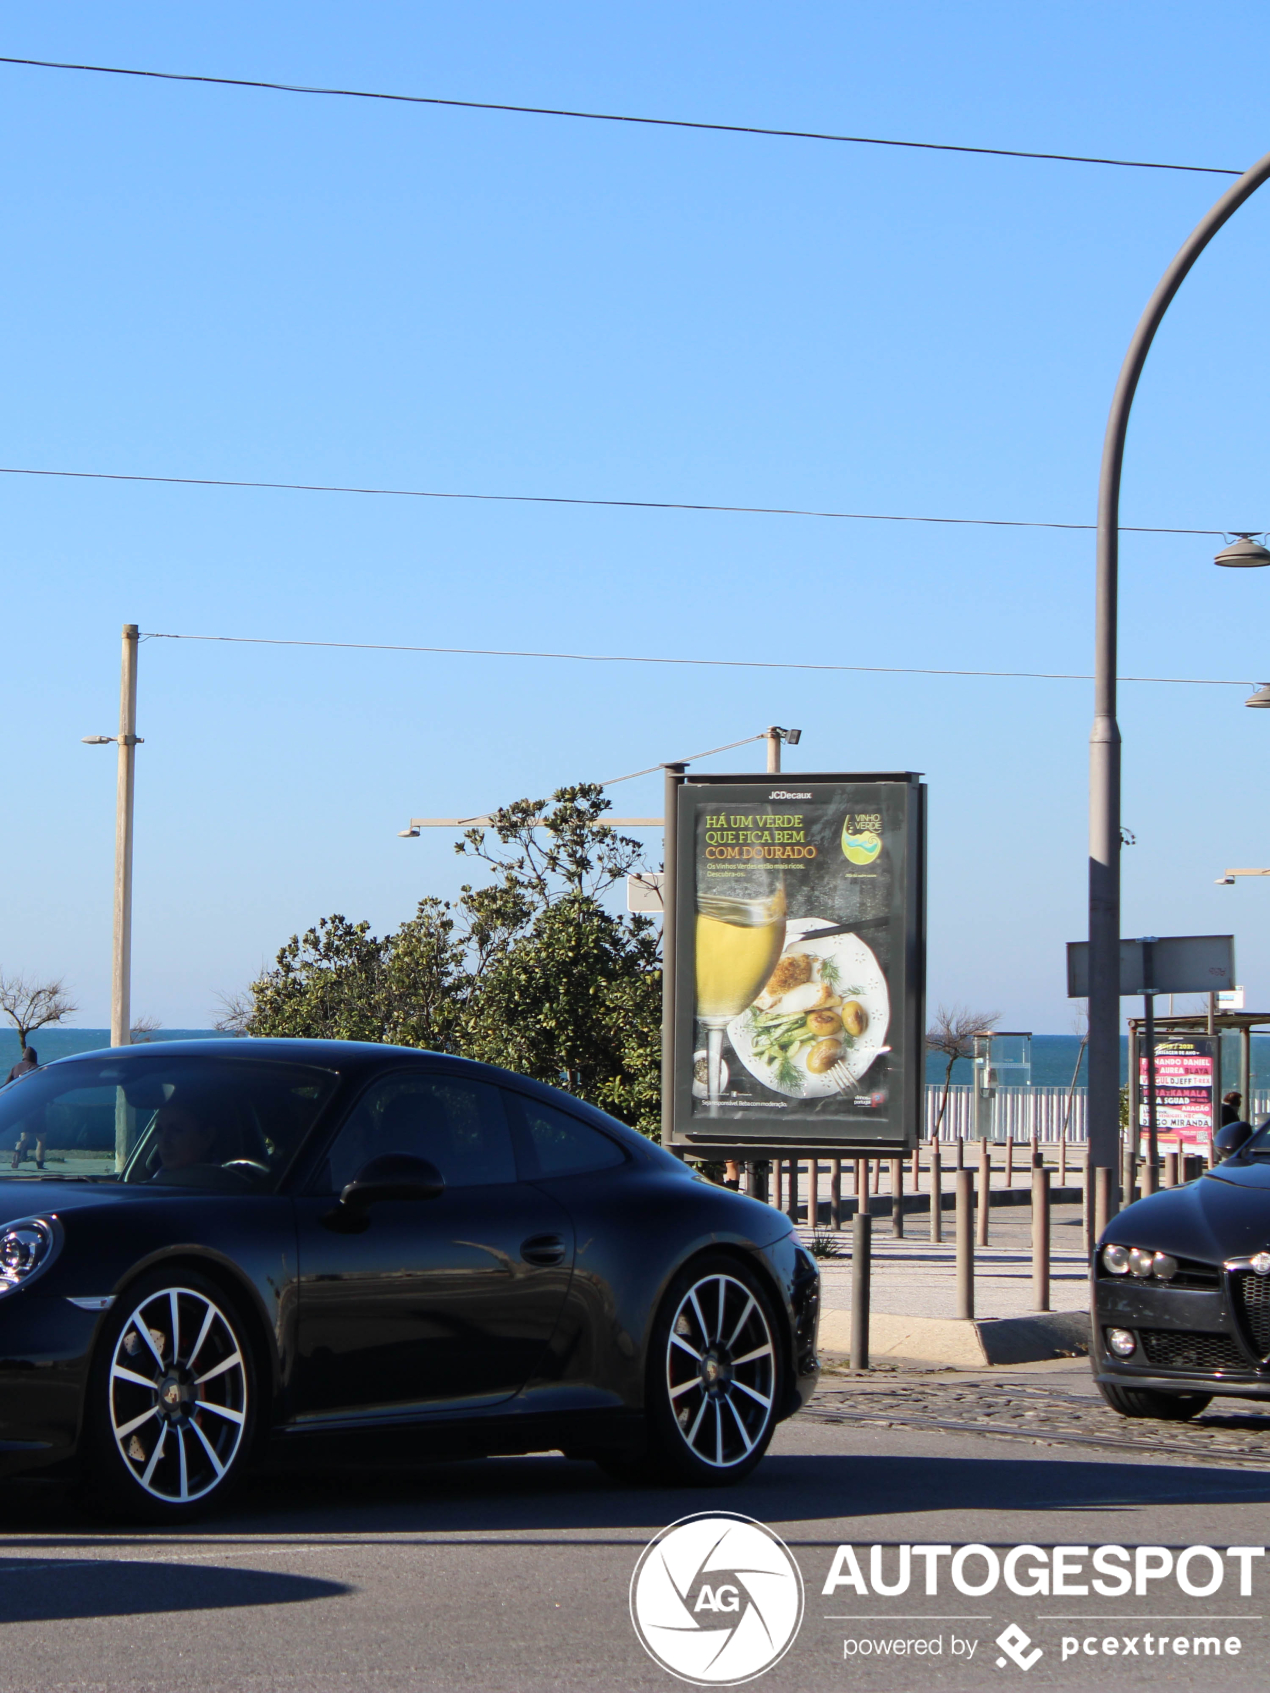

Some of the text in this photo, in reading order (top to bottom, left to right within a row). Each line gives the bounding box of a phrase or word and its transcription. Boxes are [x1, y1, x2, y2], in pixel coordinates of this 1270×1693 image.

[769, 791, 812, 799] JCDecaux
[705, 812, 803, 828] HÁ UM VERDE
[855, 814, 880, 822] VINHO
[855, 822, 882, 831] VERDE
[705, 830, 805, 845] QUE FICA BEM
[705, 846, 817, 859] COM DOURADO
[1183, 1058, 1210, 1066] DANIEL
